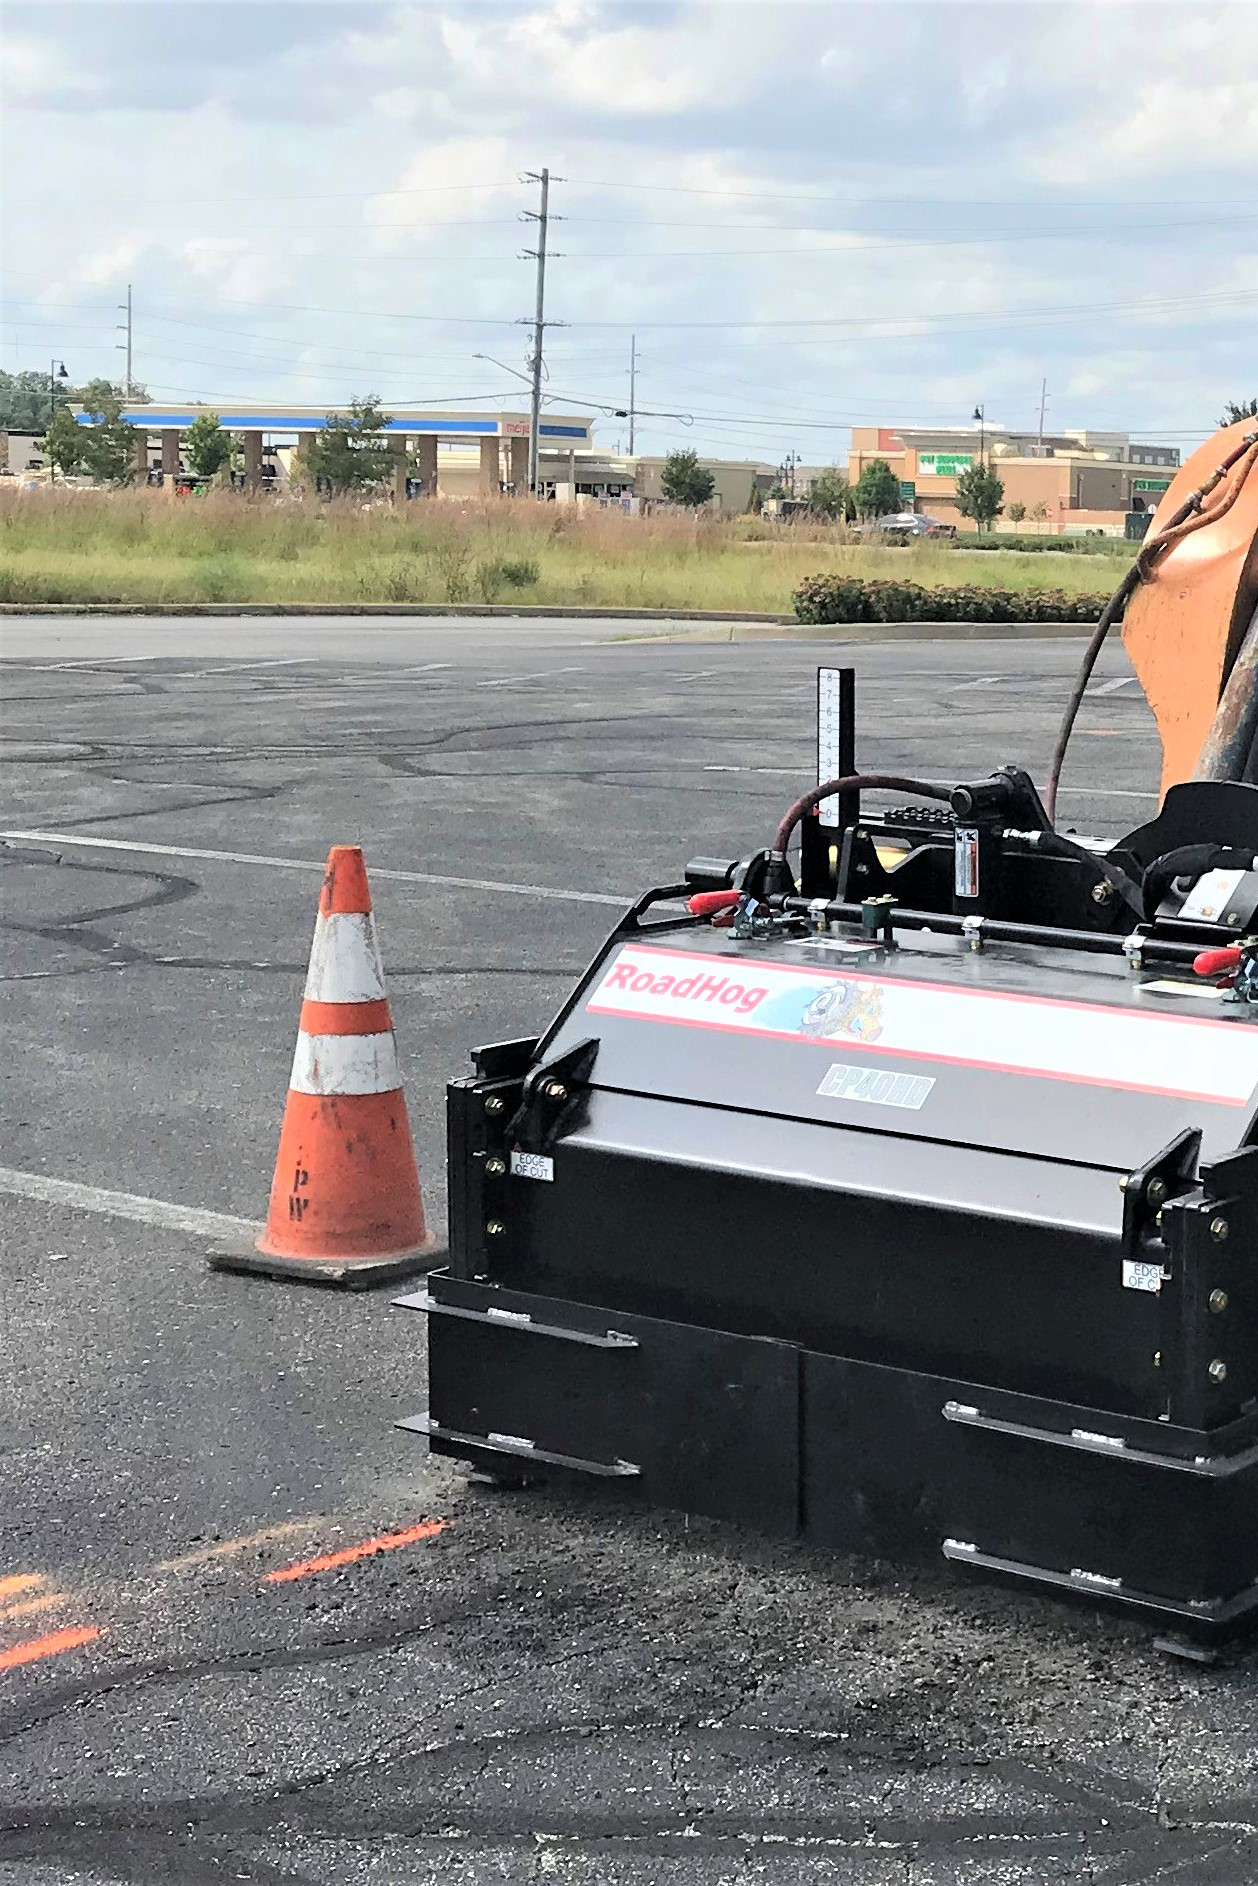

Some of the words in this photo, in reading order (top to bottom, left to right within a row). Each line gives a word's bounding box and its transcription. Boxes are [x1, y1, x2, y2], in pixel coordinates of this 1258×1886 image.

[604, 963, 770, 1014] RoadHog
[820, 1066, 932, 1107] CP40HD
[519, 1153, 545, 1167] EDGE
[515, 1164, 528, 1175] OF
[530, 1166, 548, 1179] CUT
[1128, 1276, 1144, 1287] OF
